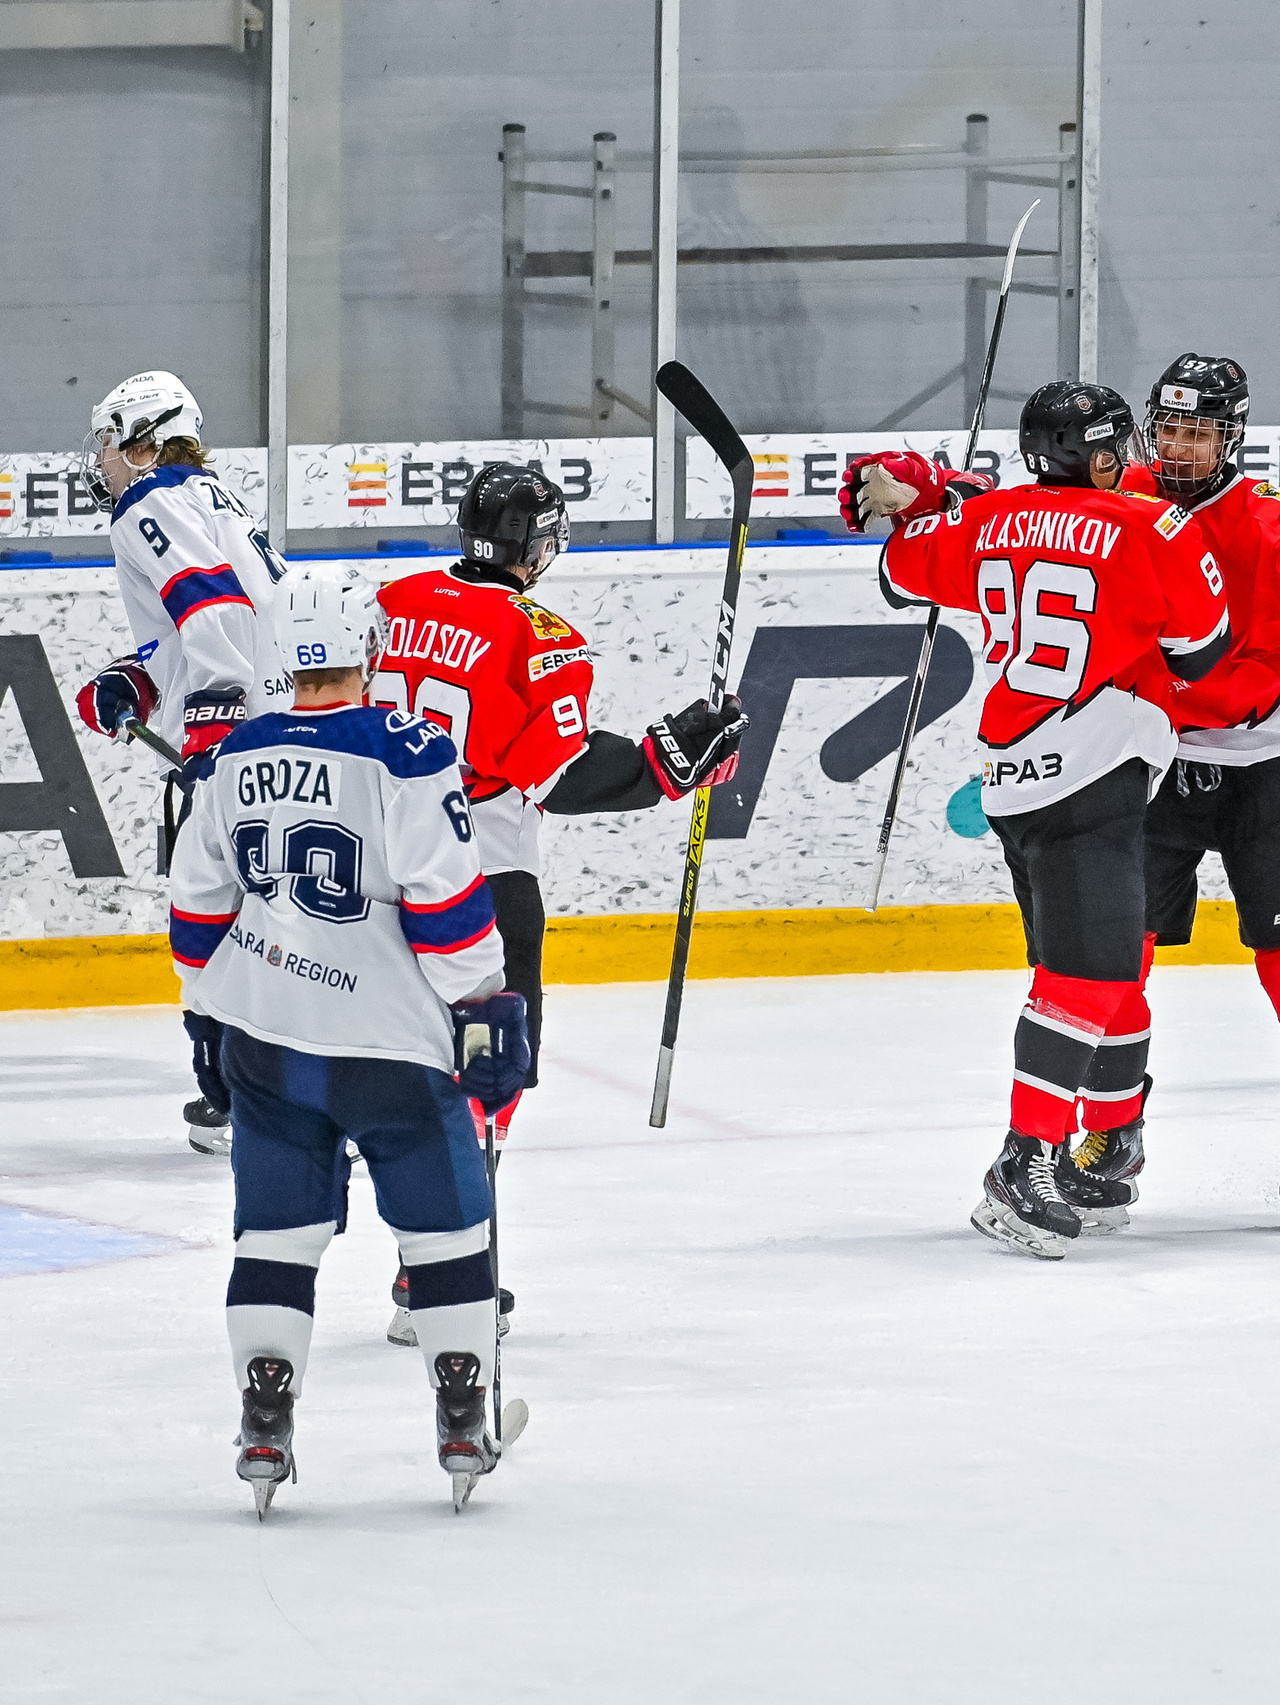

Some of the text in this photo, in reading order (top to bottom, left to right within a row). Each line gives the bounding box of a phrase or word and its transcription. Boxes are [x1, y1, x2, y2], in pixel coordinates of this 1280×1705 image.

[1026, 452, 1050, 472] 86
[138, 517, 172, 558] 9
[473, 539, 494, 560] 90
[433, 587, 462, 598] LUTCH
[386, 616, 492, 674] OLOSOV
[978, 557, 1099, 701] 86
[296, 642, 328, 667] 69
[542, 649, 594, 672] ЕВРА
[708, 599, 735, 714] CCM
[184, 705, 248, 723] BAUE
[551, 694, 585, 739] 9
[238, 757, 333, 807] GROZA
[989, 752, 1064, 787] РАЗ
[442, 790, 476, 844] 6
[682, 869, 695, 918] SUPER
[284, 952, 358, 993] REGION
